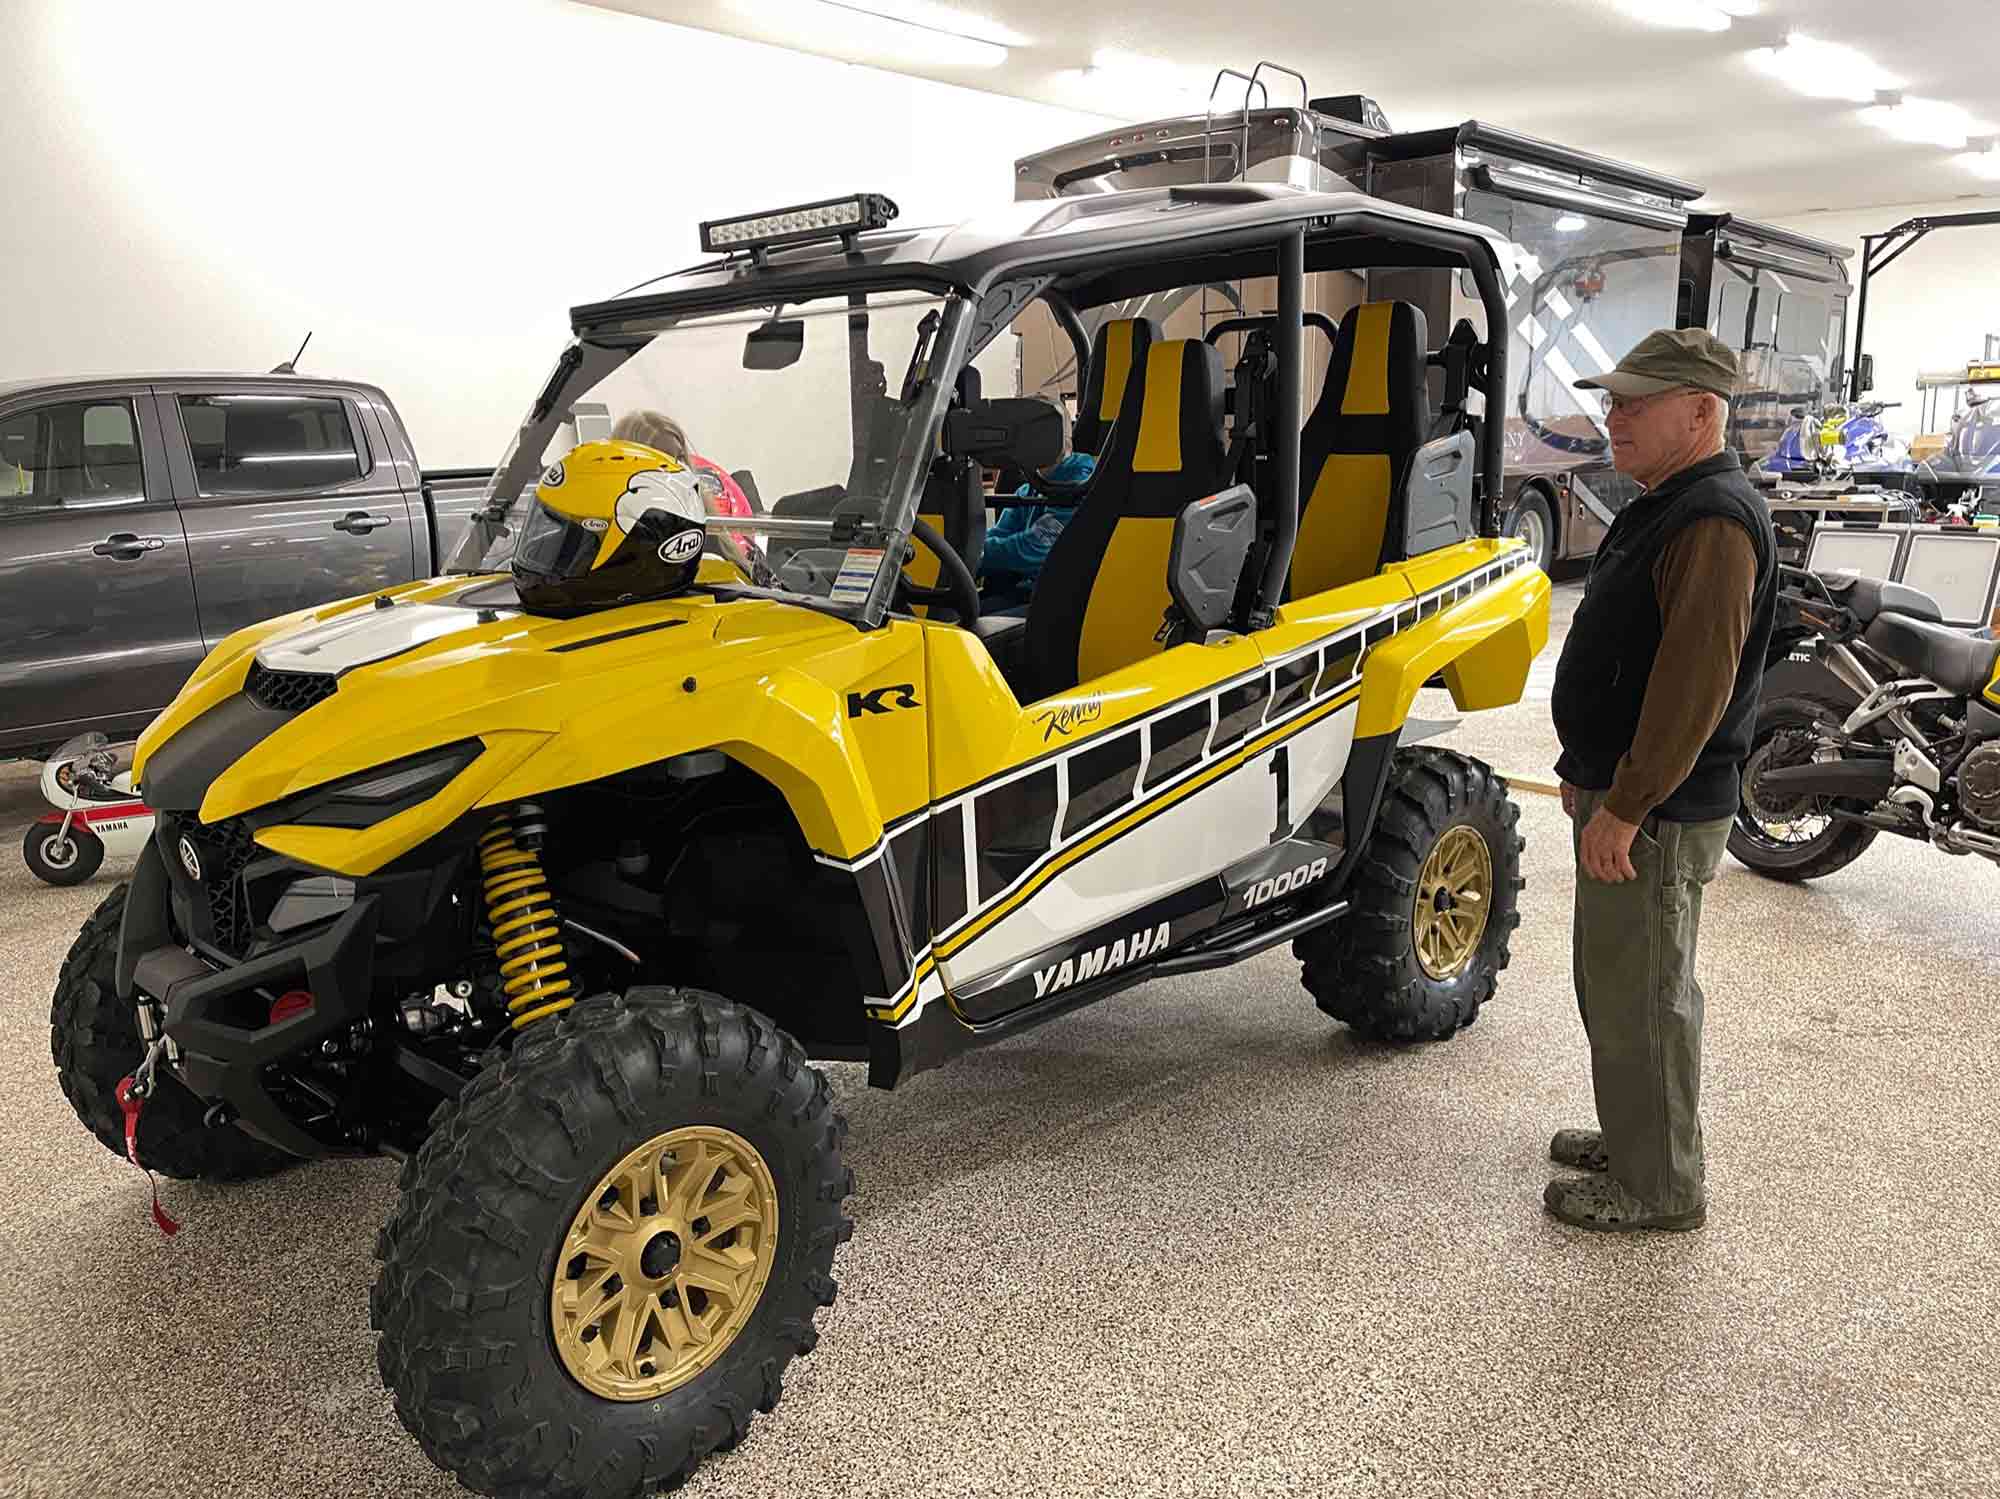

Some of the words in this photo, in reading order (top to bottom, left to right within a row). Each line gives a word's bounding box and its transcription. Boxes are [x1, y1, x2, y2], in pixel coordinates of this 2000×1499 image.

[664, 532, 700, 558] Arai
[1783, 652, 1811, 663] ETIC
[847, 683, 923, 718] KR
[1031, 690, 1102, 743] Kenny
[1268, 744, 1294, 846] 1
[95, 821, 129, 833] YAMAHA
[1243, 856, 1328, 910] 1000R
[1033, 920, 1171, 1000] YAMAHA
